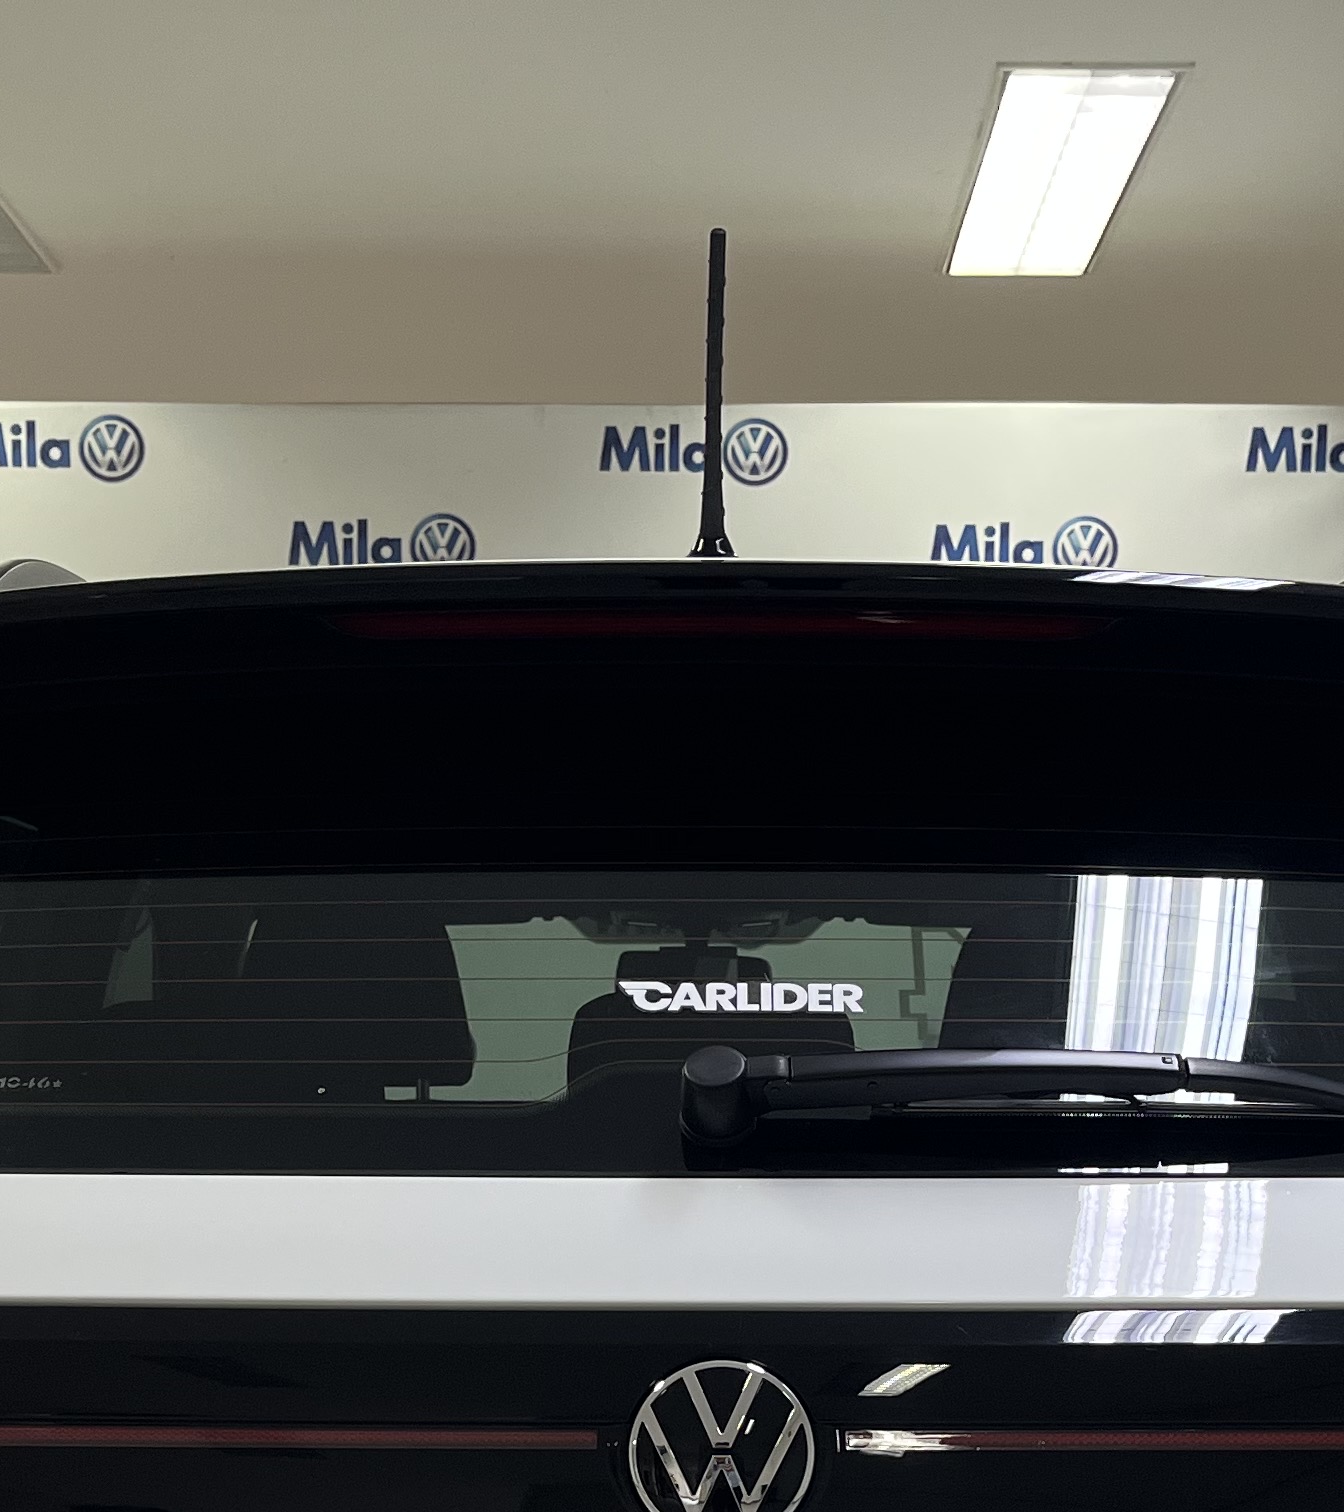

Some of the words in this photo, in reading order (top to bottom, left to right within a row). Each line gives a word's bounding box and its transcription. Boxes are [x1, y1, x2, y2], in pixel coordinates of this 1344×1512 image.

[80, 415, 144, 481] VW
[724, 419, 787, 484] VW
[289, 519, 402, 565] Mila
[930, 522, 1044, 564] Mila
[619, 981, 864, 1013] CARLIDER
